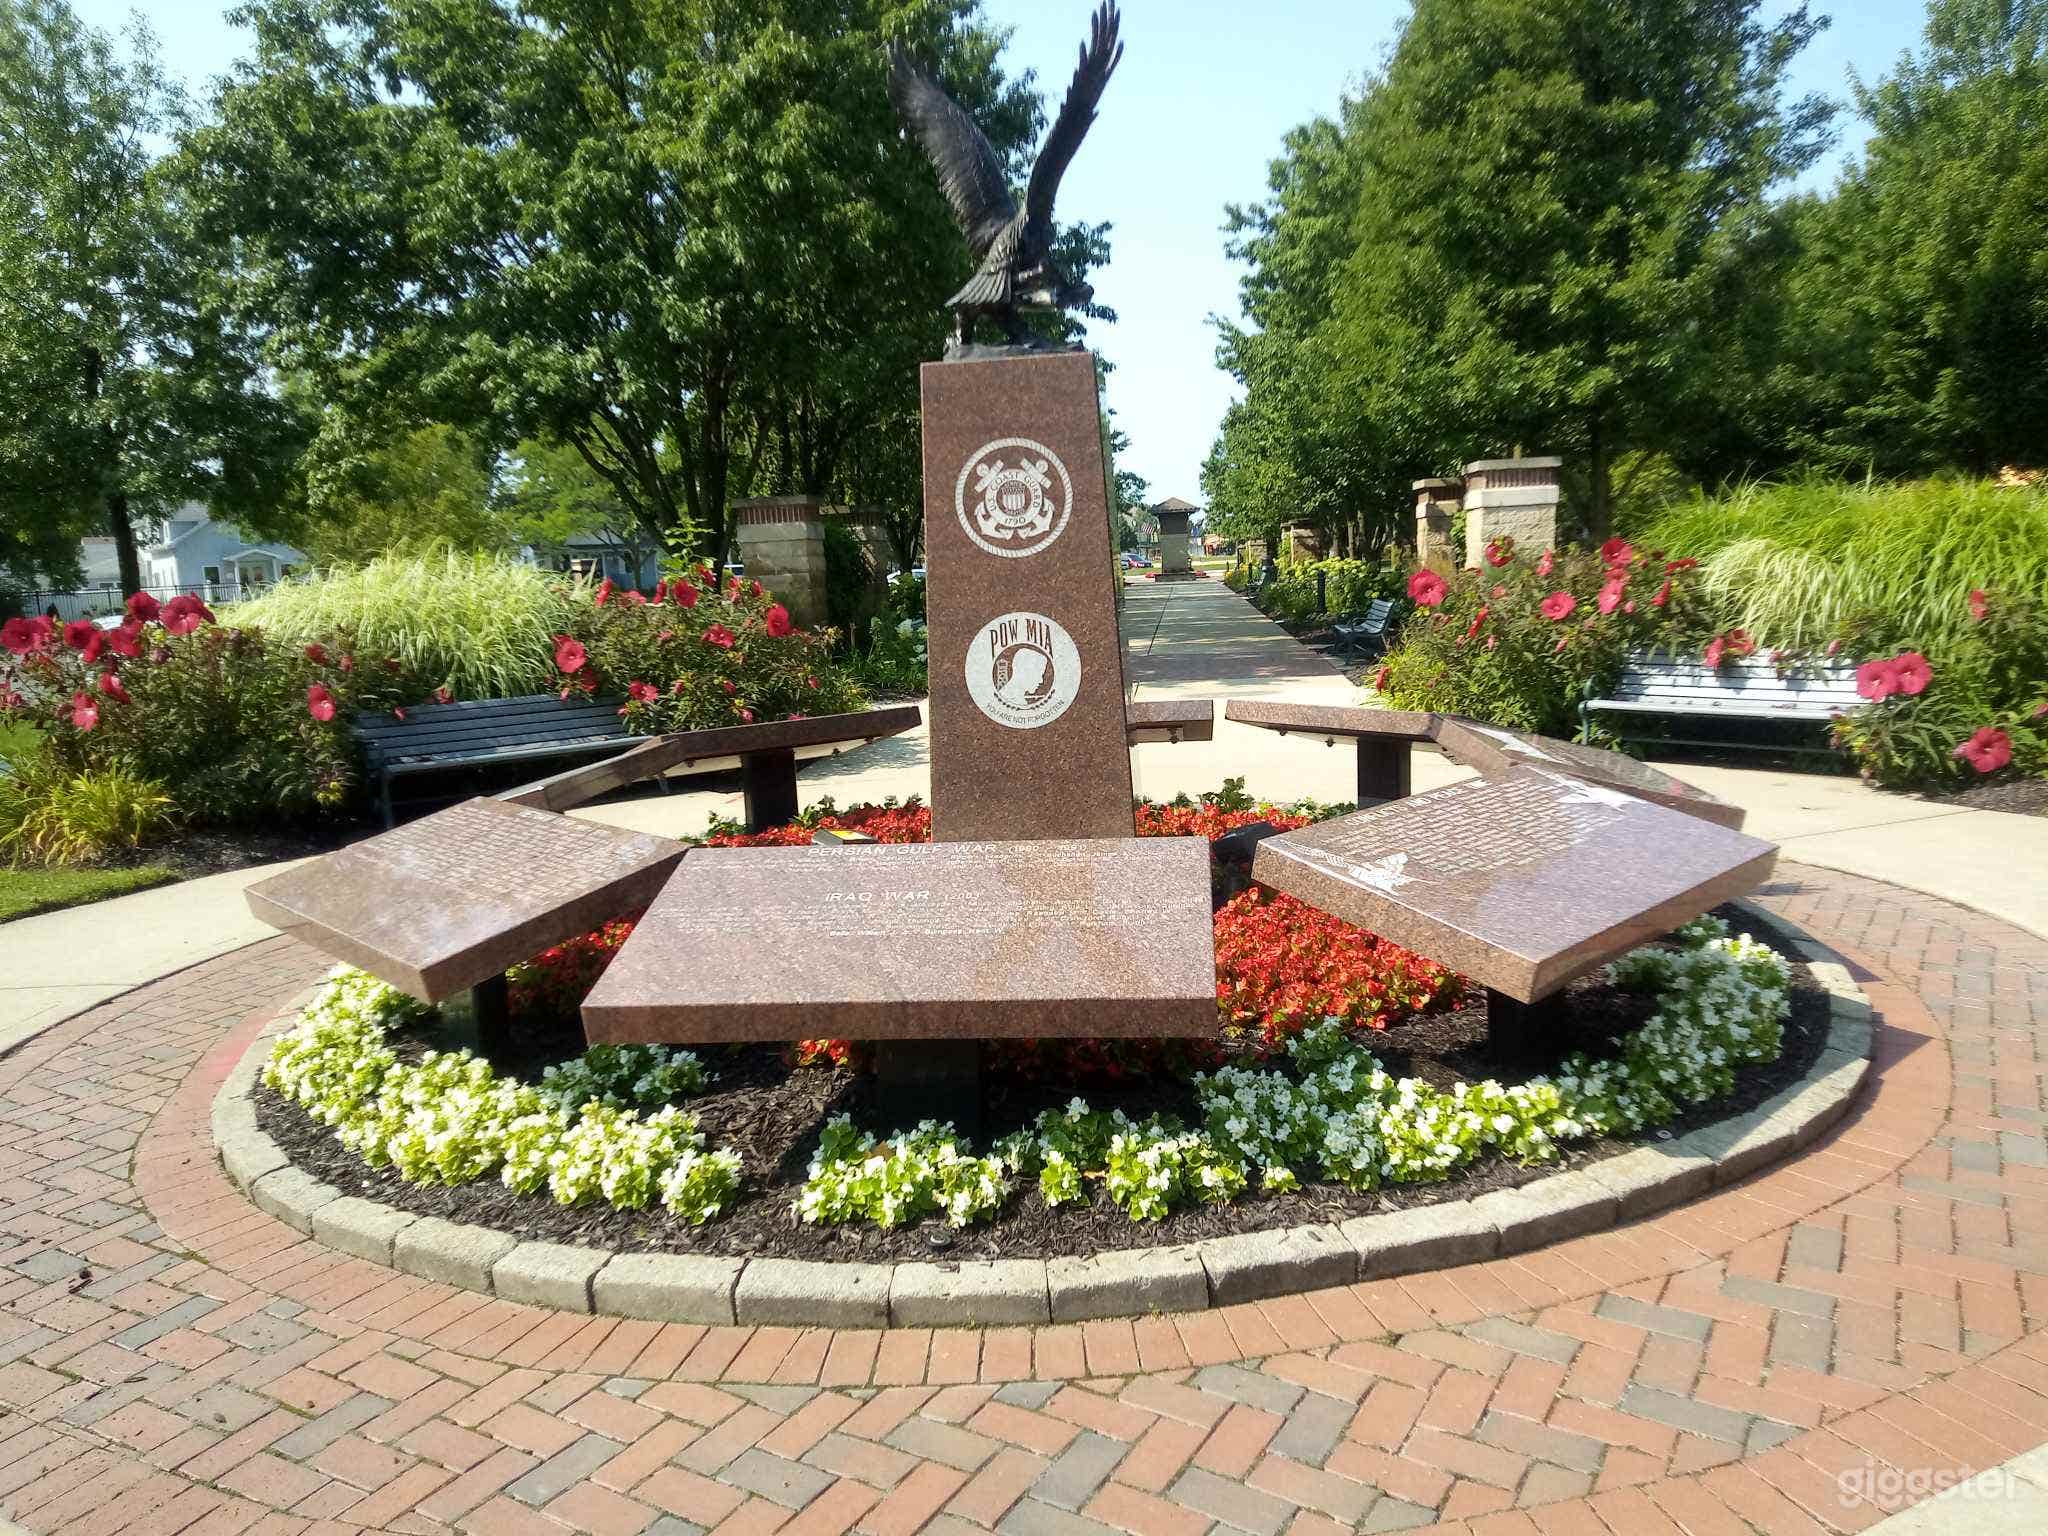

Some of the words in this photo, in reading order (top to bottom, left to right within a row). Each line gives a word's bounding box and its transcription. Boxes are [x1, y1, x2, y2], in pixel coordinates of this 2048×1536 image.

[991, 471, 1018, 491] COAST
[1024, 475, 1041, 508] GUARD
[1004, 516, 1026, 525] 1790
[990, 619, 1018, 660] POW
[1025, 618, 1053, 660] MIA
[986, 703, 1000, 717] YOU
[999, 711, 1013, 723] ARE
[807, 847, 886, 857] PERSIAN
[897, 844, 943, 856] GULF
[953, 844, 997, 854] WAR
[825, 891, 872, 902] IRAQ
[883, 889, 931, 902] WAR
